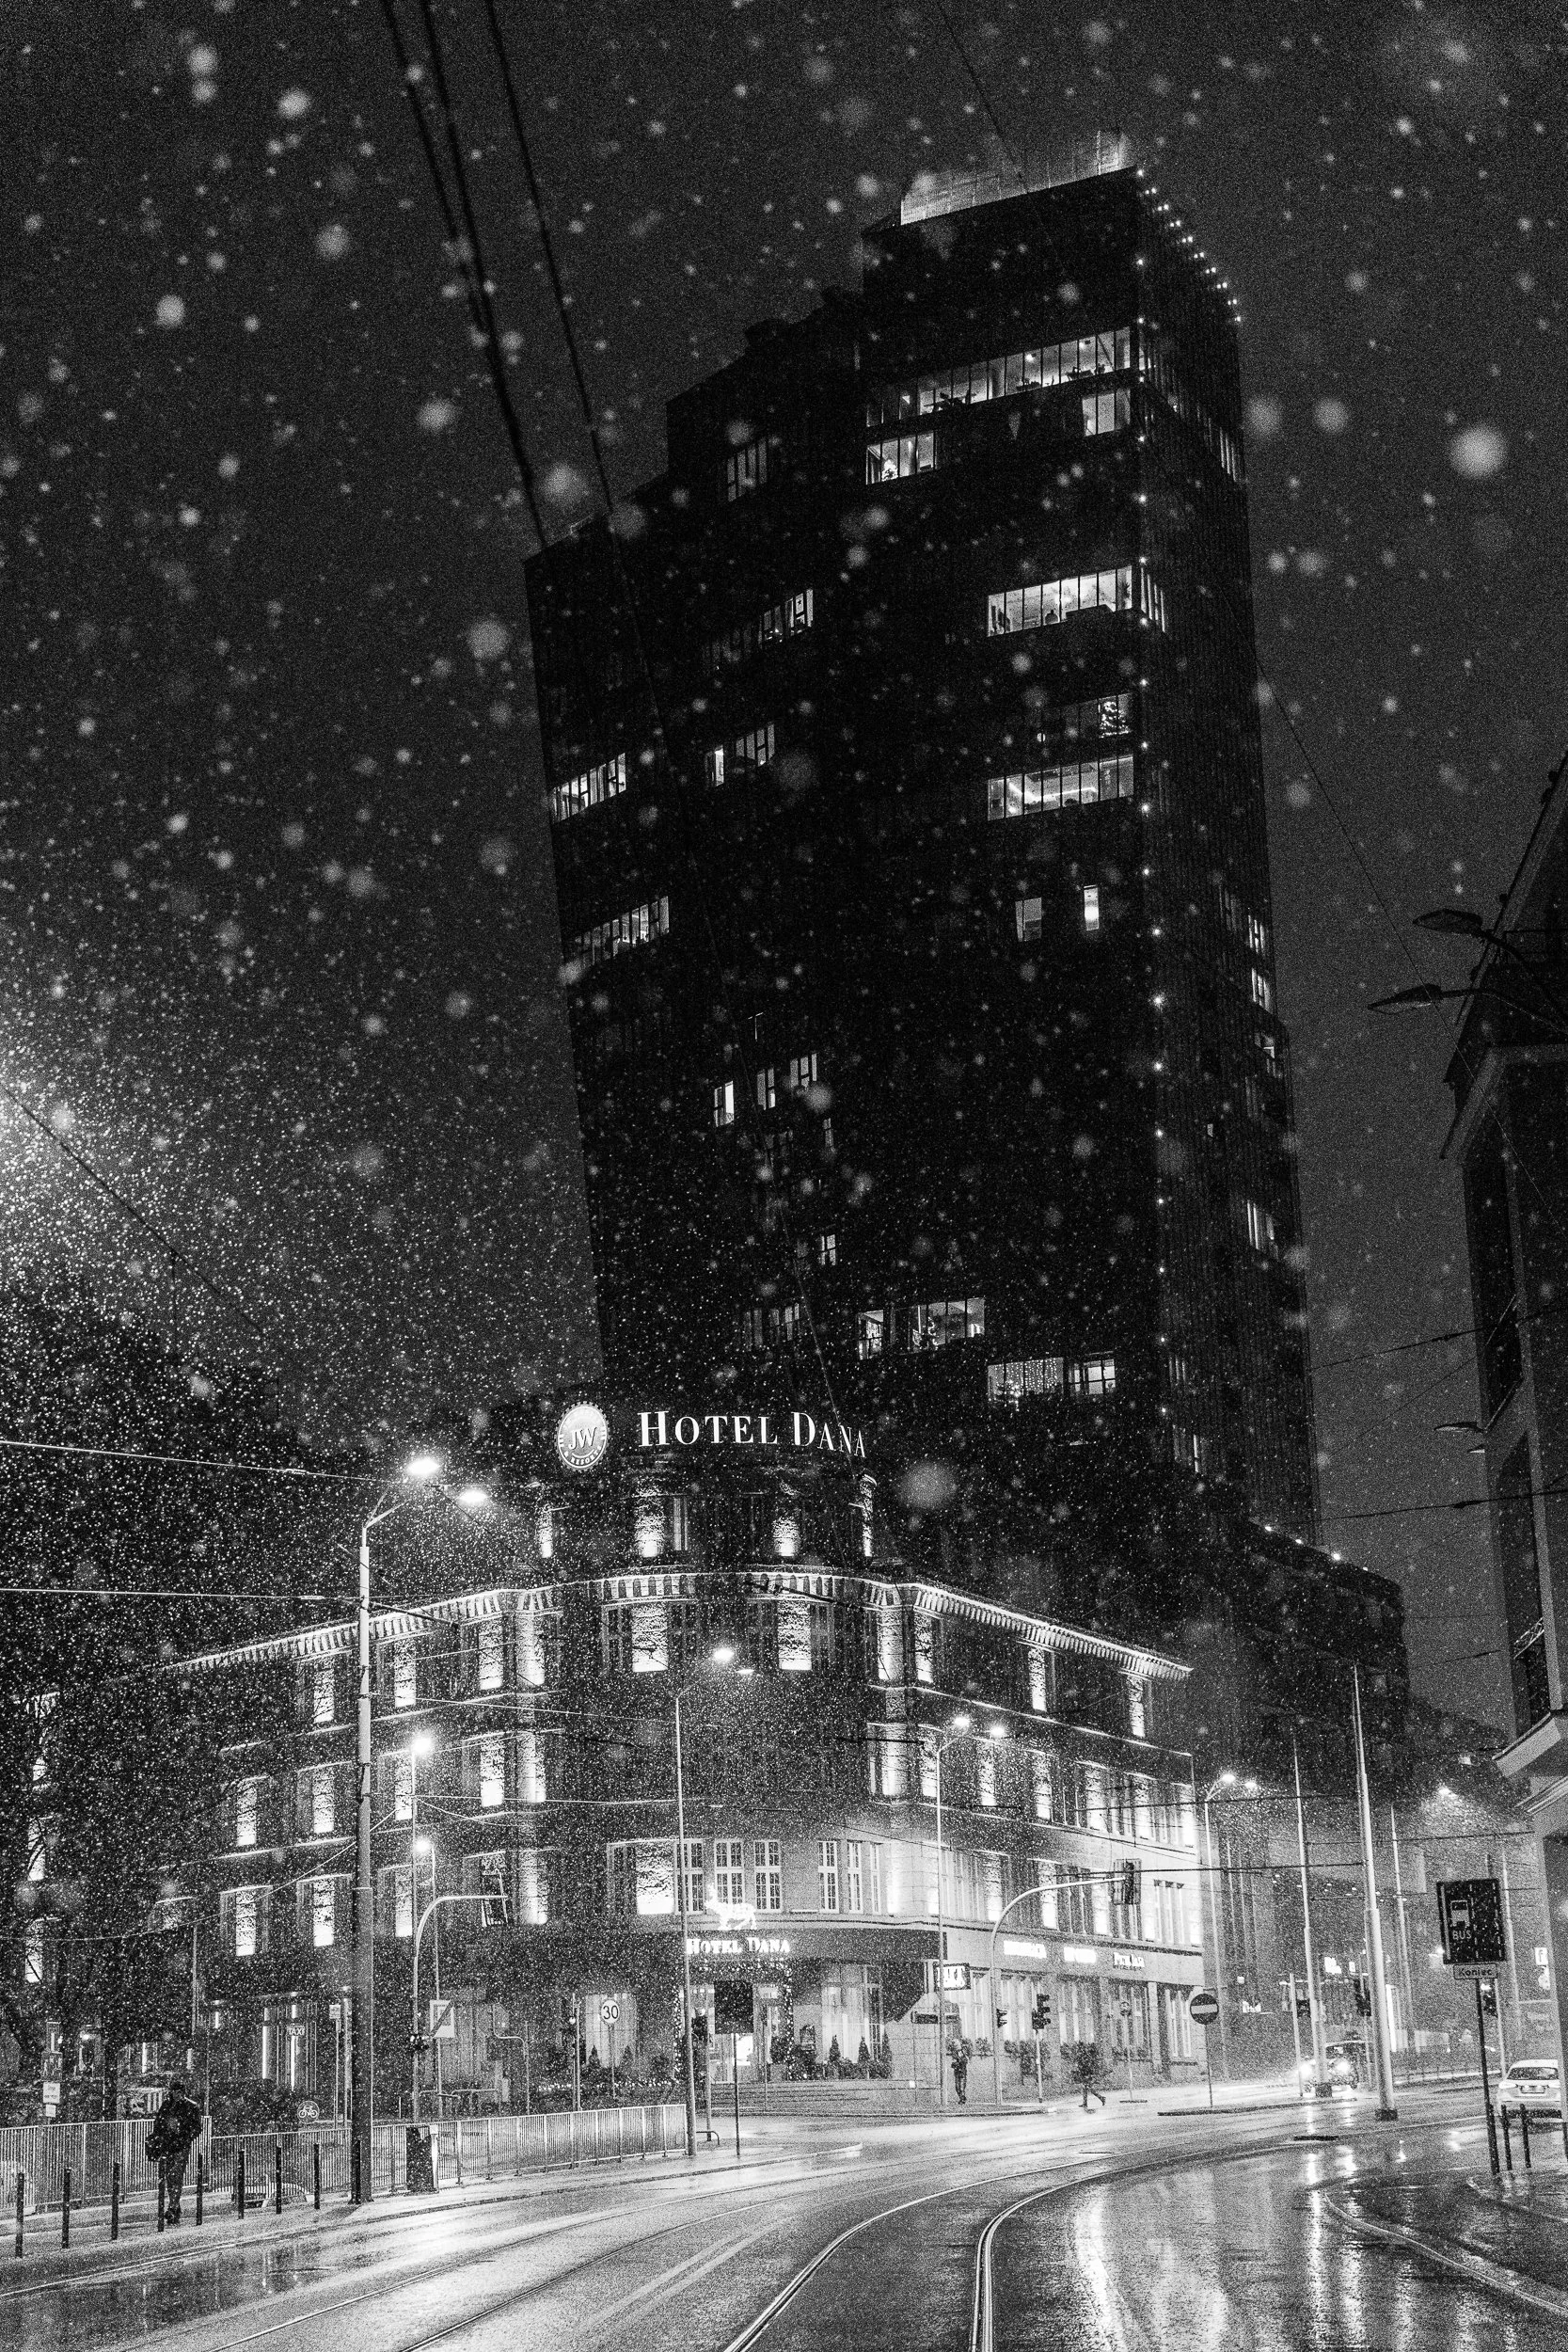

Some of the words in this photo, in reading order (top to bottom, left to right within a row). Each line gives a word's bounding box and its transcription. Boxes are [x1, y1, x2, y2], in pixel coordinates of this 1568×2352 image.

[637, 1410, 779, 1448] HOTEL
[791, 1411, 866, 1458] DANA
[1452, 1930, 1472, 1940] BUS
[686, 1938, 742, 1954] HOTEL
[747, 1937, 790, 1953] DANA
[1458, 1967, 1494, 1977] Koniec
[603, 2005, 619, 2020] 30
